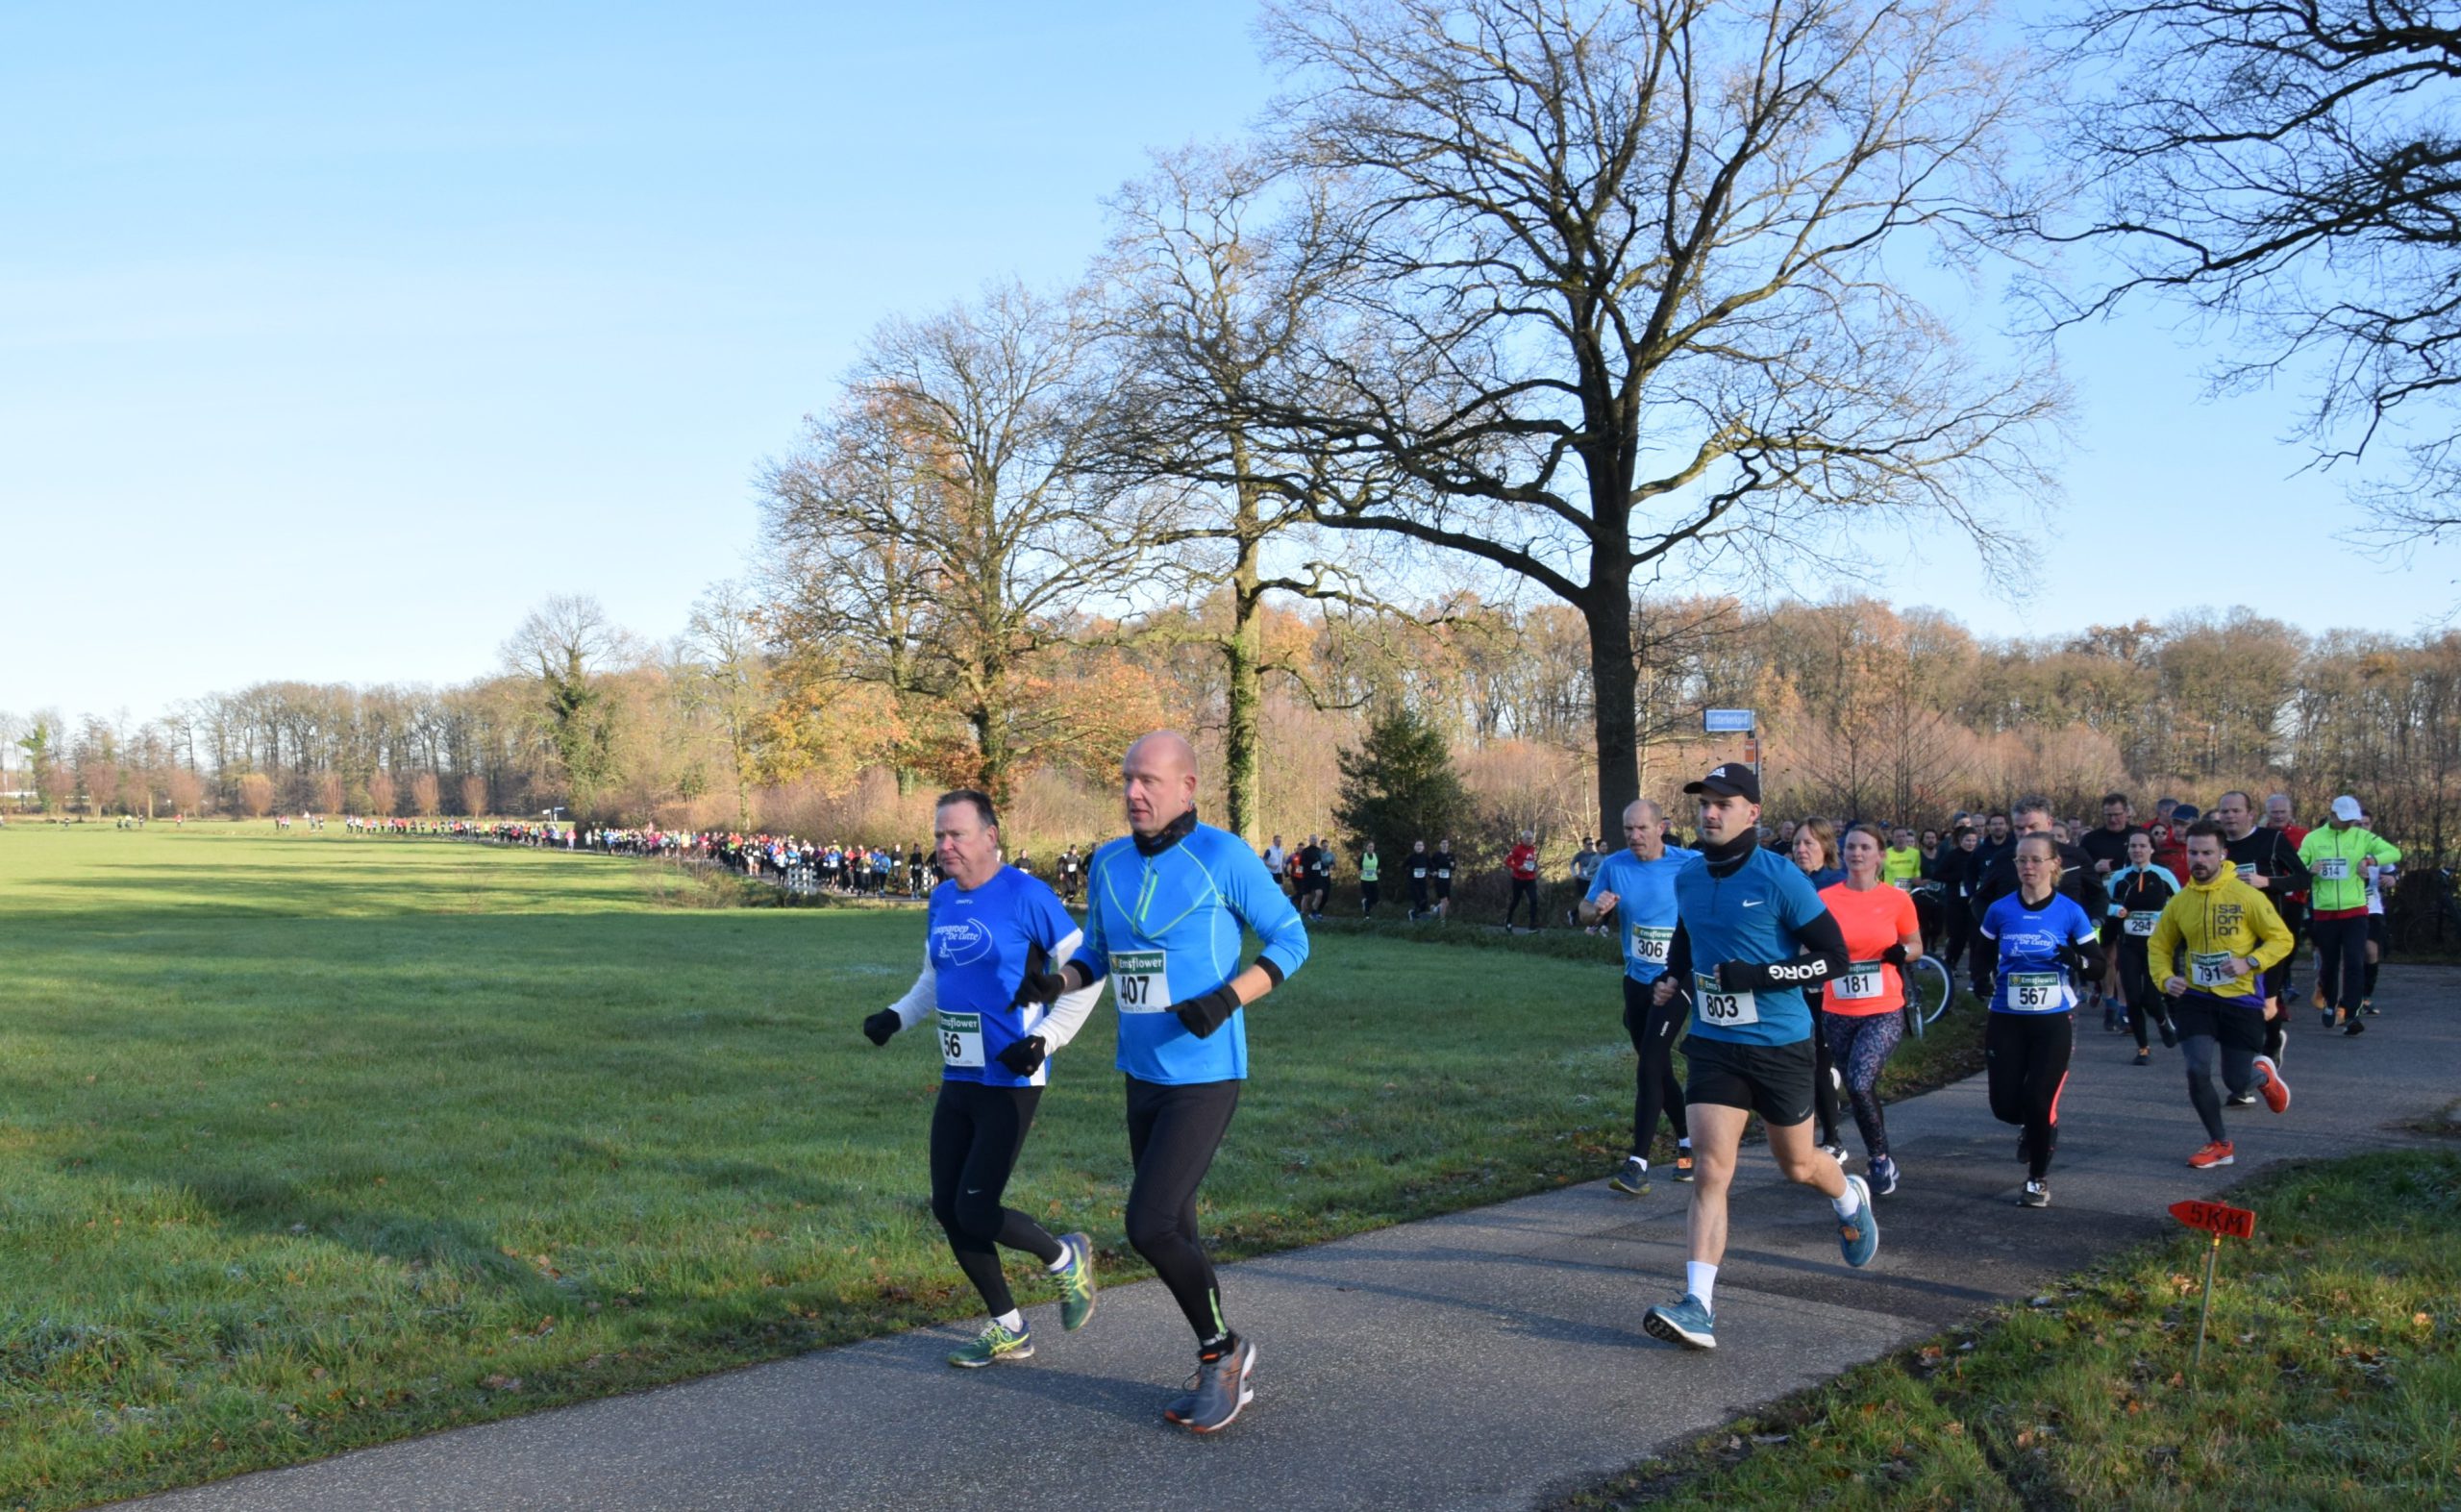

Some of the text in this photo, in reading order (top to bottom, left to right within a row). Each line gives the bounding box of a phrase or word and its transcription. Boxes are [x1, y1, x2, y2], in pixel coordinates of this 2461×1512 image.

[2322, 866, 2340, 876] 814
[2131, 921, 2151, 931] 294
[1638, 938, 1663, 958] 306
[1120, 956, 1162, 972] Emsflower
[1769, 959, 1827, 980] BORG
[2199, 965, 2221, 982] 791
[1121, 976, 1150, 1004] 407
[1843, 975, 1869, 994] 181
[2020, 987, 2049, 1005] 567
[1706, 995, 1739, 1019] 803
[944, 1031, 961, 1058] 56
